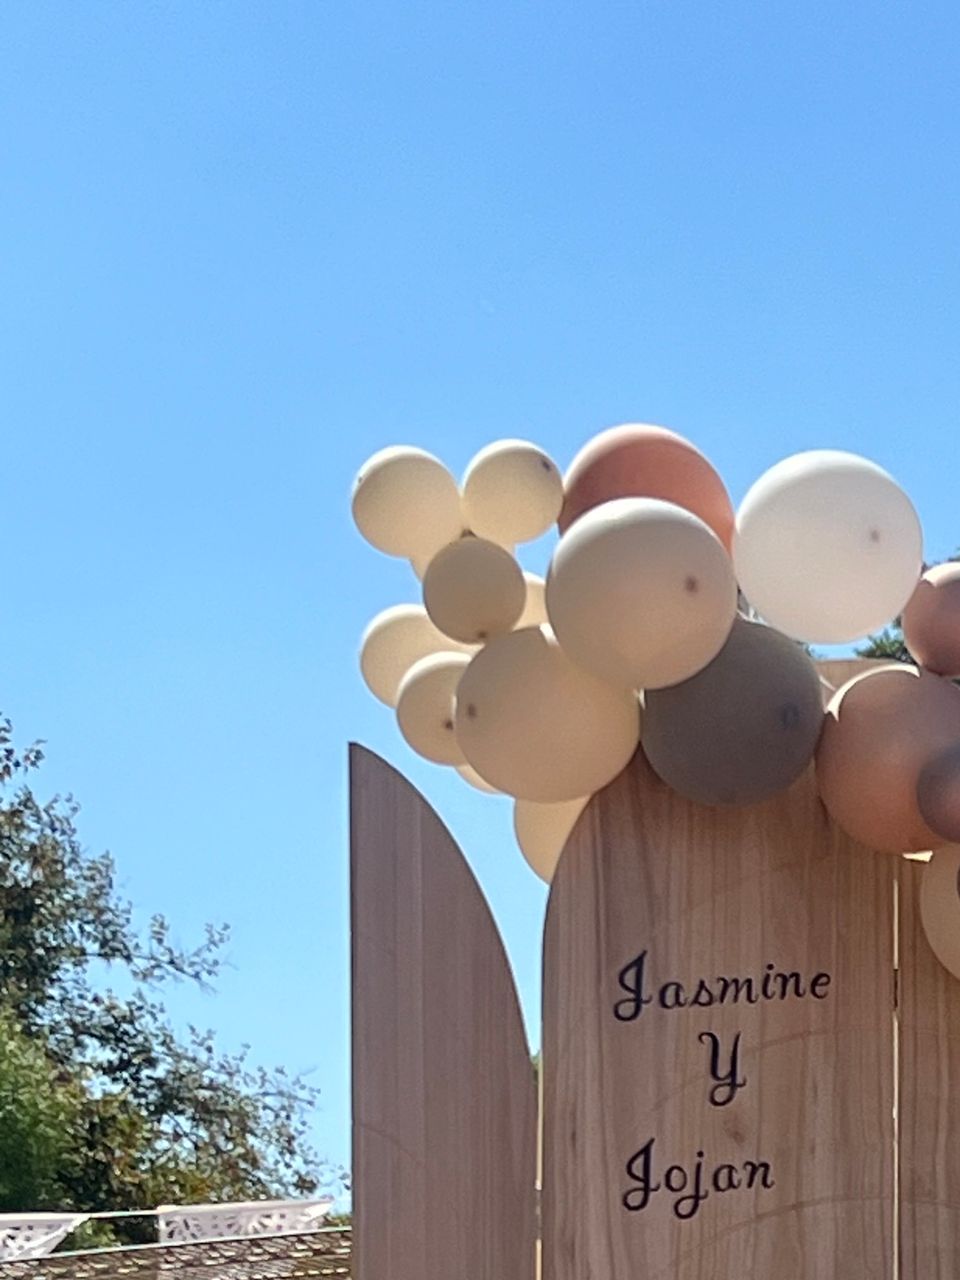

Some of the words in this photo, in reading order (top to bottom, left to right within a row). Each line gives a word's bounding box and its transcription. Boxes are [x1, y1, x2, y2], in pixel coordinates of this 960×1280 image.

[613, 949, 832, 1022] Jasmine
[697, 1031, 747, 1107] Y
[621, 1137, 775, 1220] Jojan
